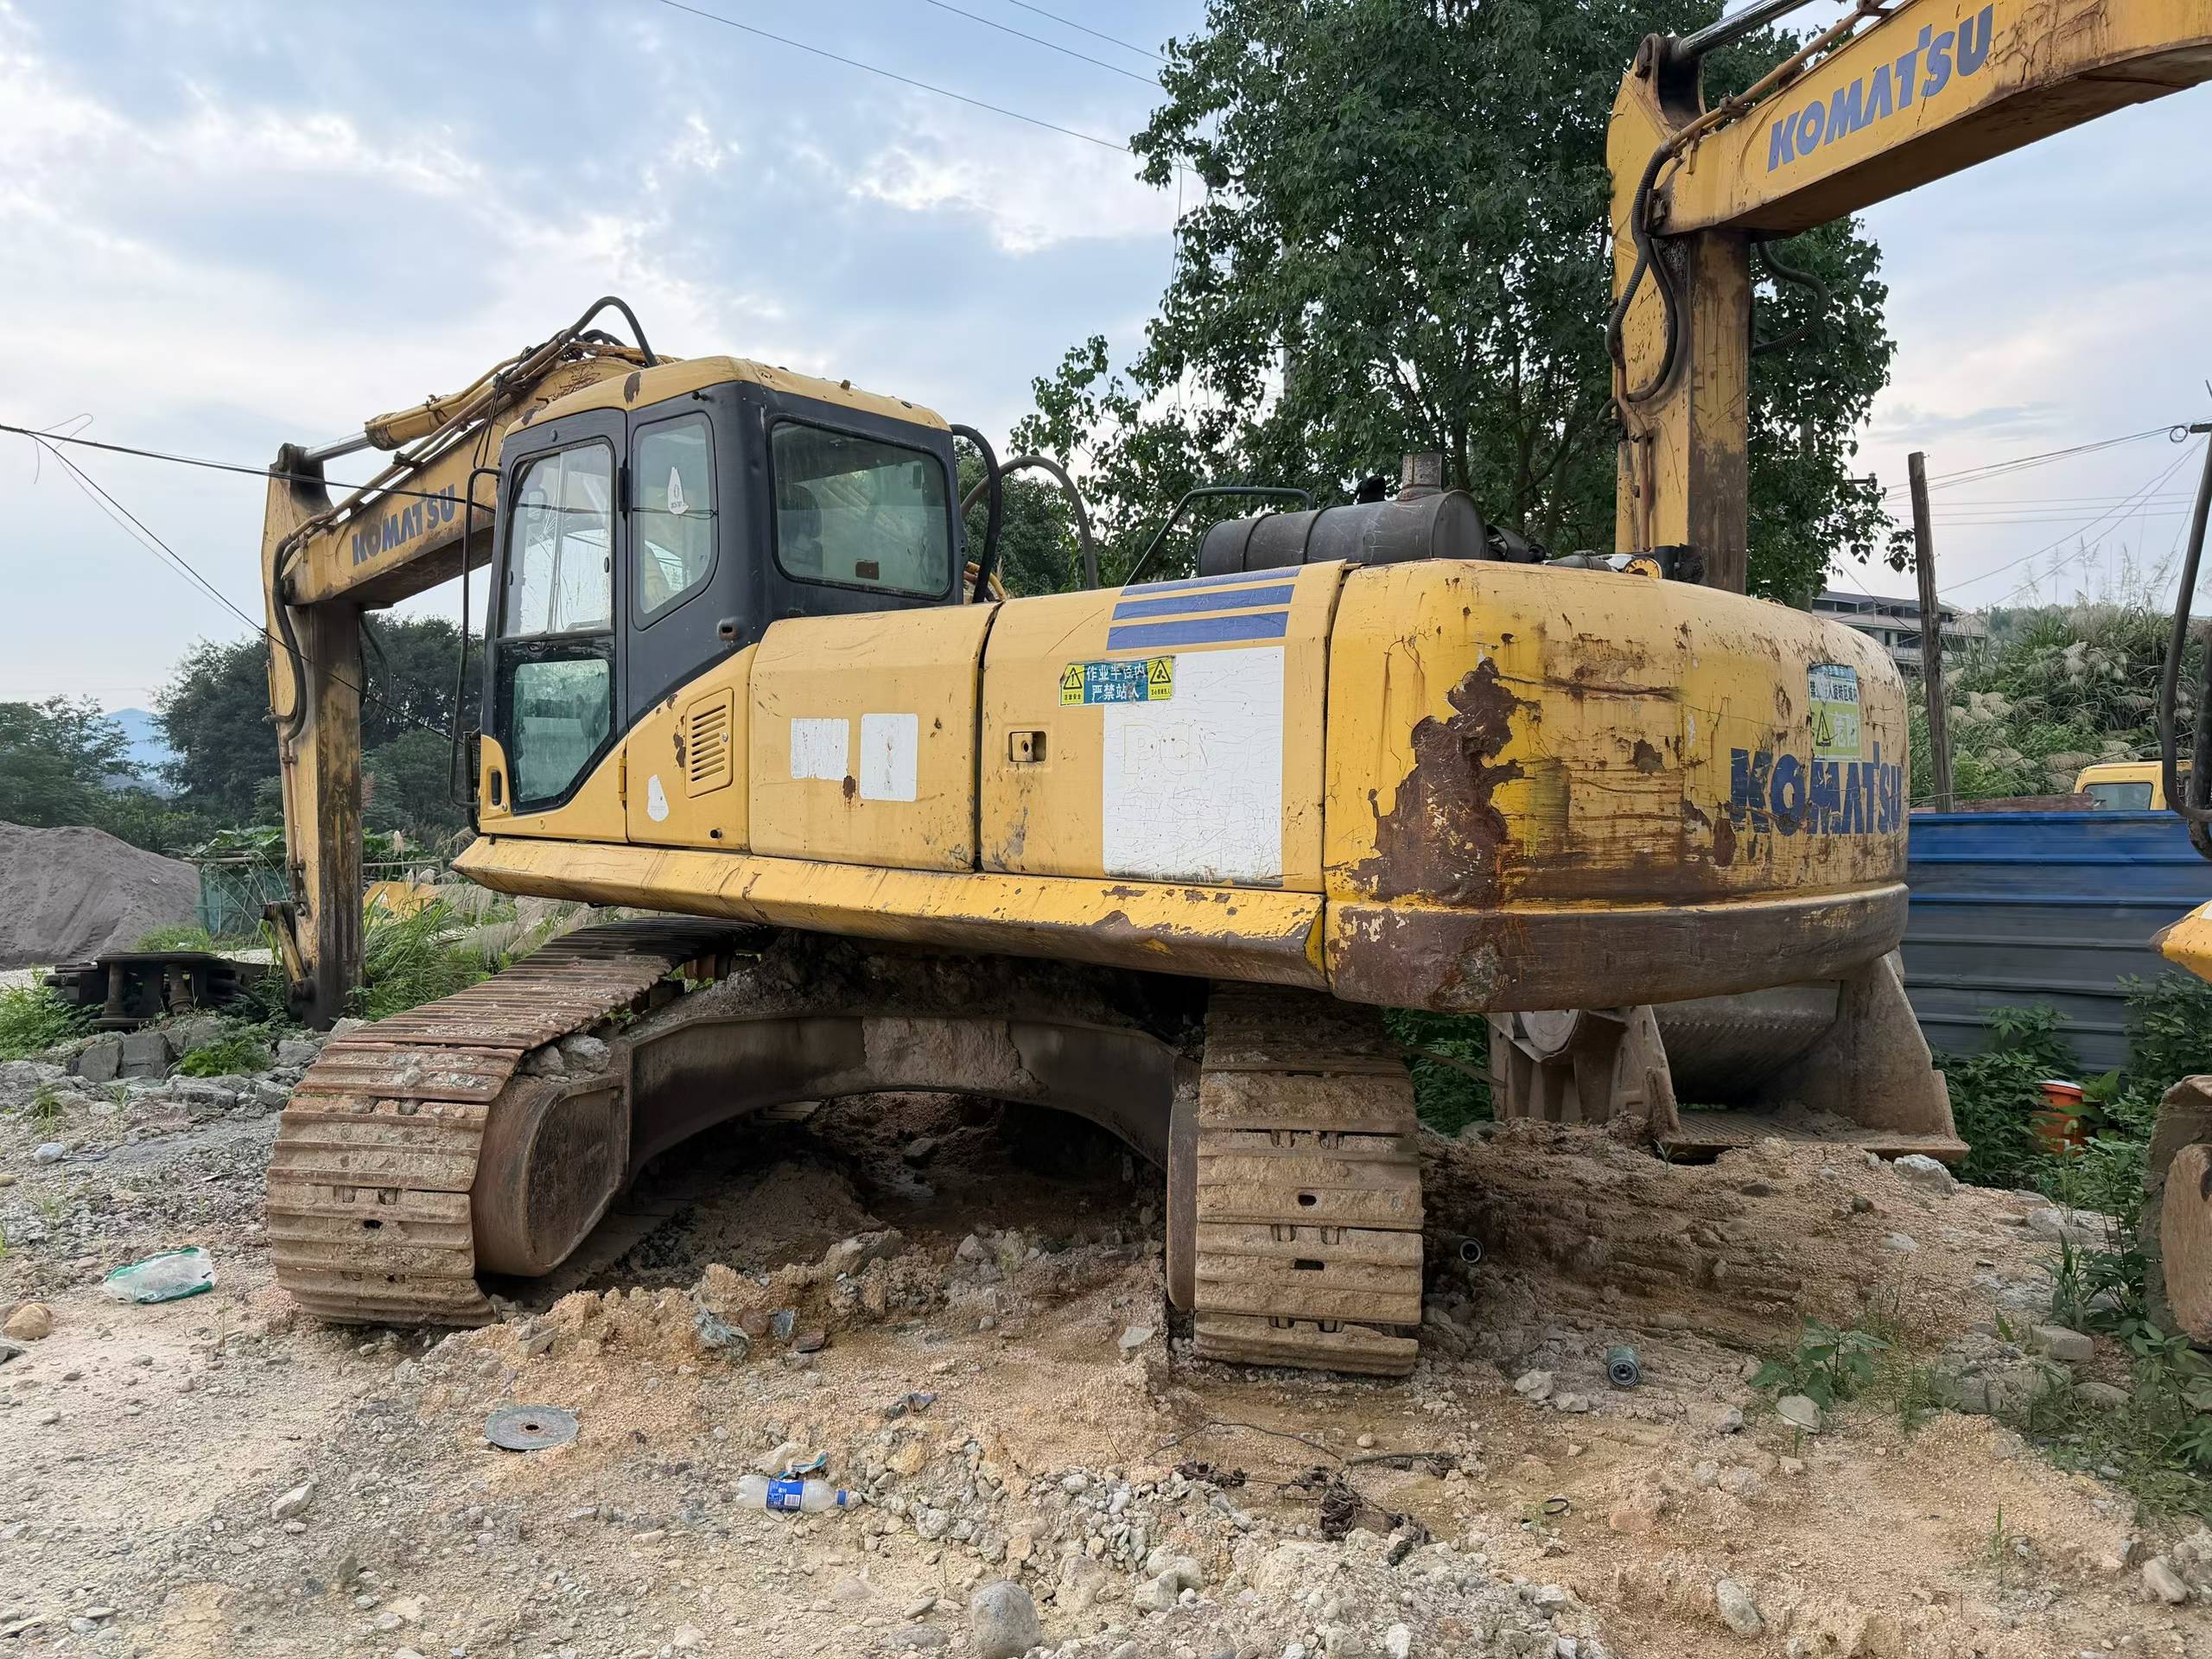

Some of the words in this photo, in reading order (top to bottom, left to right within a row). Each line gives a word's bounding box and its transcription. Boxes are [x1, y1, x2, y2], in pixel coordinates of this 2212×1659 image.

[1767, 5, 1993, 173] KOMATSU
[352, 484, 455, 566] KOMATSU
[1730, 741, 1901, 836] KOMATSU
